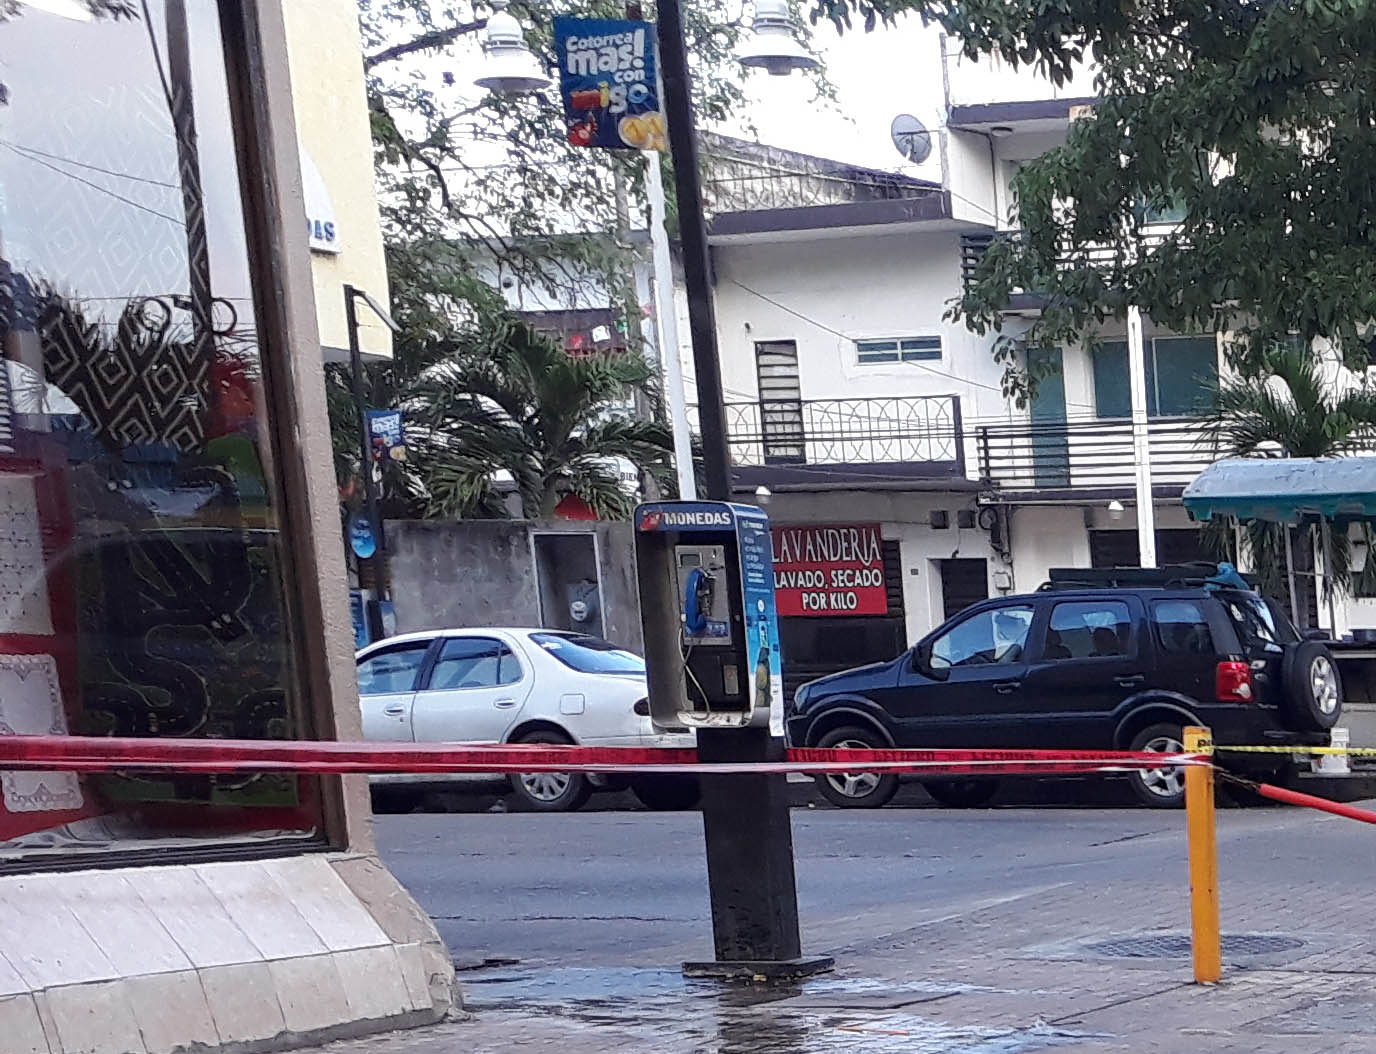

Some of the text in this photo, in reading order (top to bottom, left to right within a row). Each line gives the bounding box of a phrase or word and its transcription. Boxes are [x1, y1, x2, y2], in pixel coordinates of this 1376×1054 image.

[614, 69, 645, 82] con
[663, 512, 732, 525] MONEDAS
[773, 570, 828, 590] LAVADO,
[830, 568, 882, 588] SECADO
[801, 591, 858, 610] POR KILO
